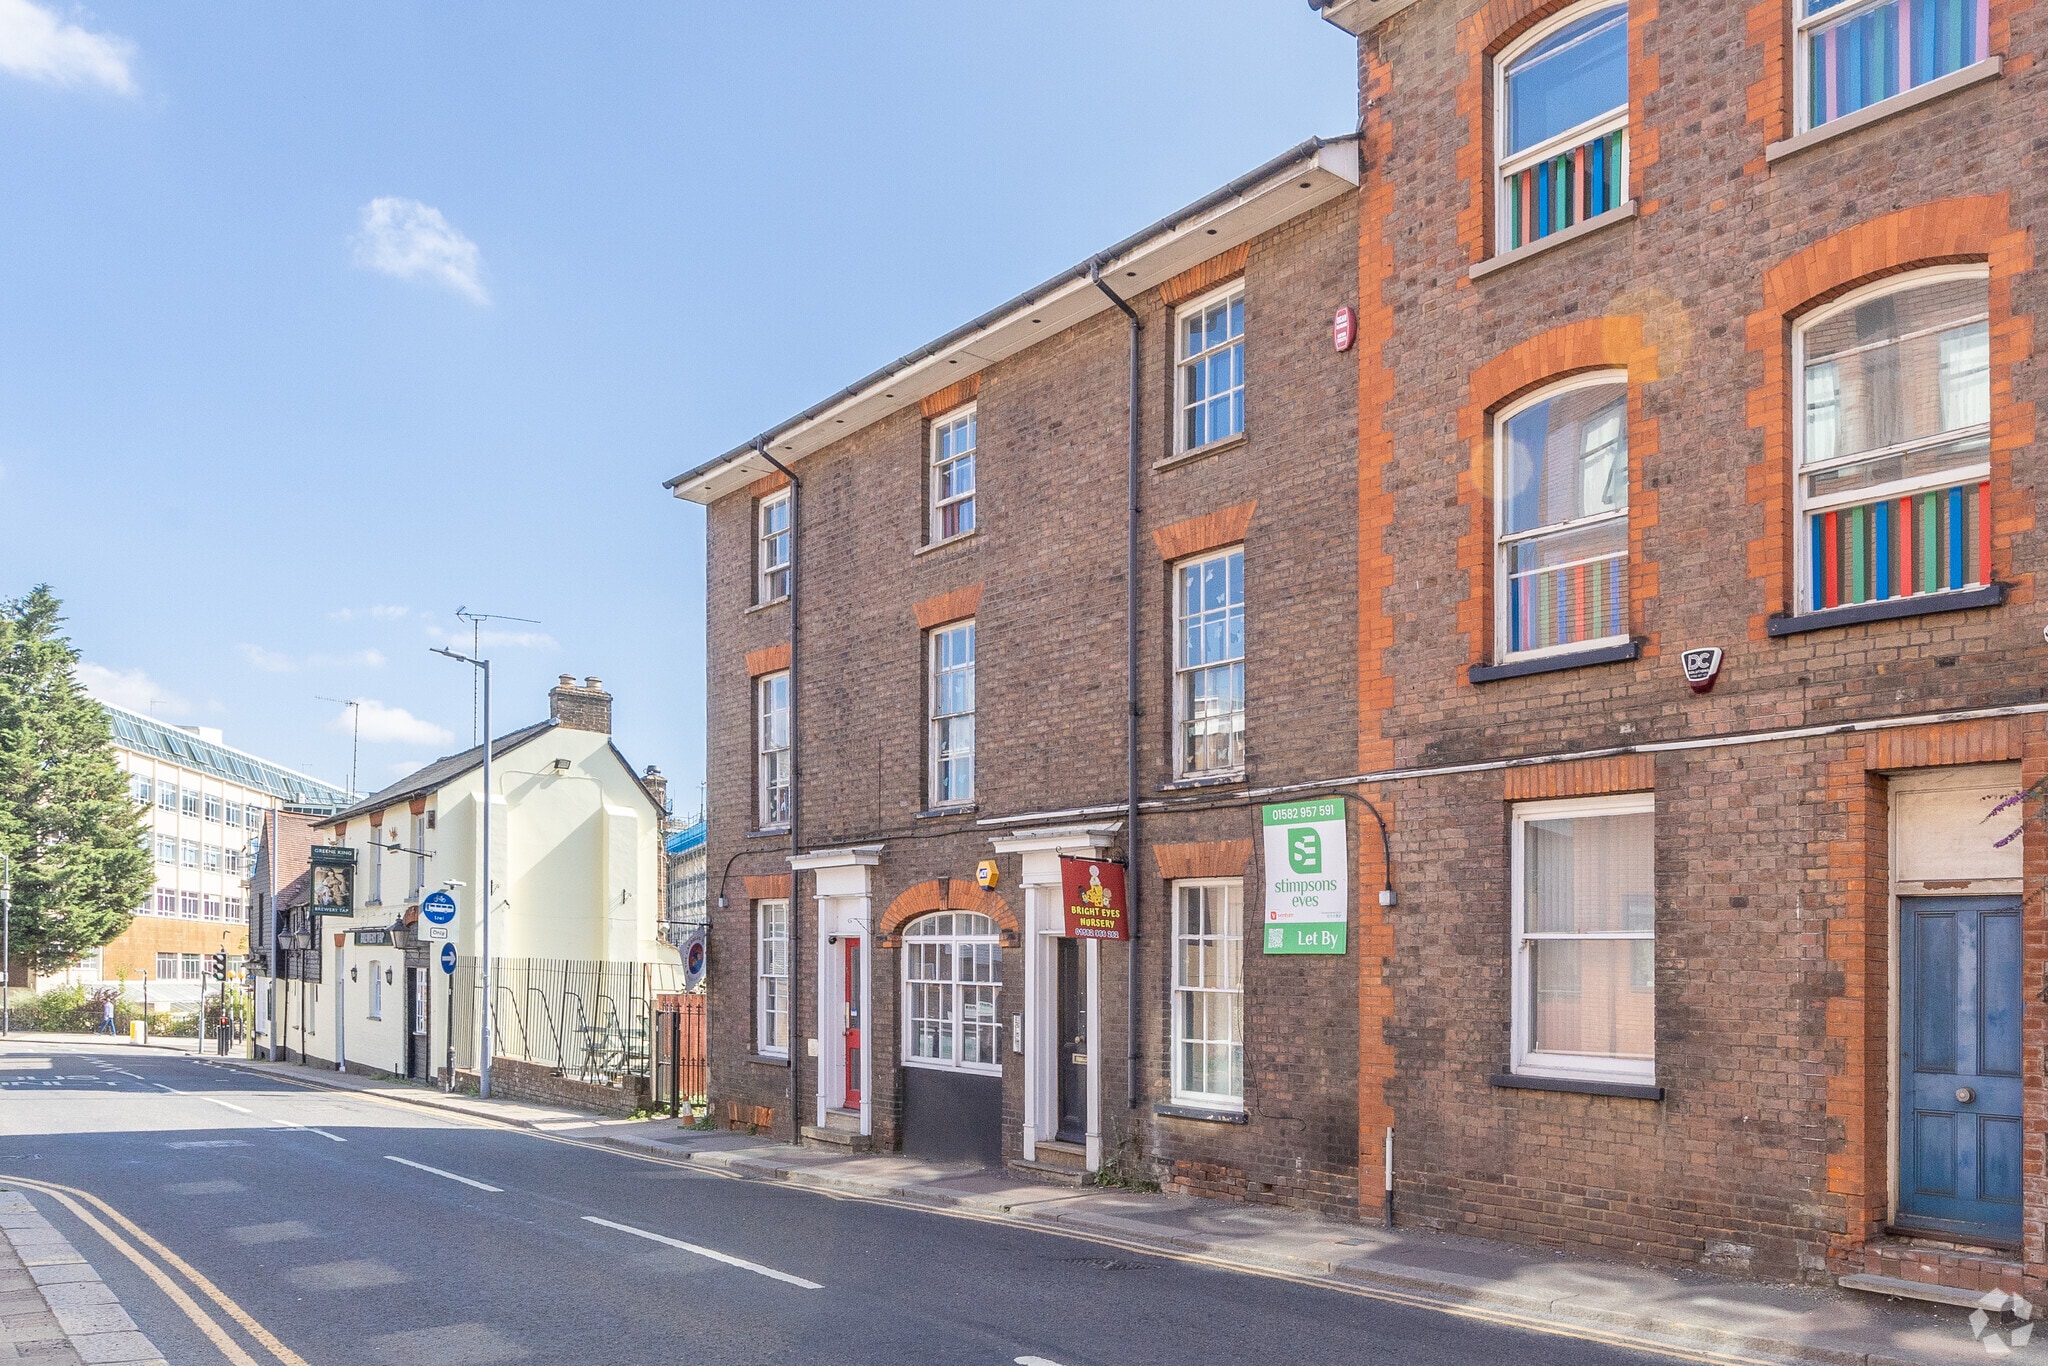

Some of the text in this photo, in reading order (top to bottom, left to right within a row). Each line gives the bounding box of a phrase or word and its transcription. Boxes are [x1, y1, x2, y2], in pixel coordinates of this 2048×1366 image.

[1688, 652, 1710, 670] DC
[1273, 804, 1334, 820] 01582 957 591
[1275, 879, 1337, 895] stimpsons
[1292, 896, 1319, 907] eves
[1071, 906, 1120, 918] BRIGHT EYES
[1080, 918, 1115, 928] NURSERY
[1298, 931, 1338, 949] Let By
